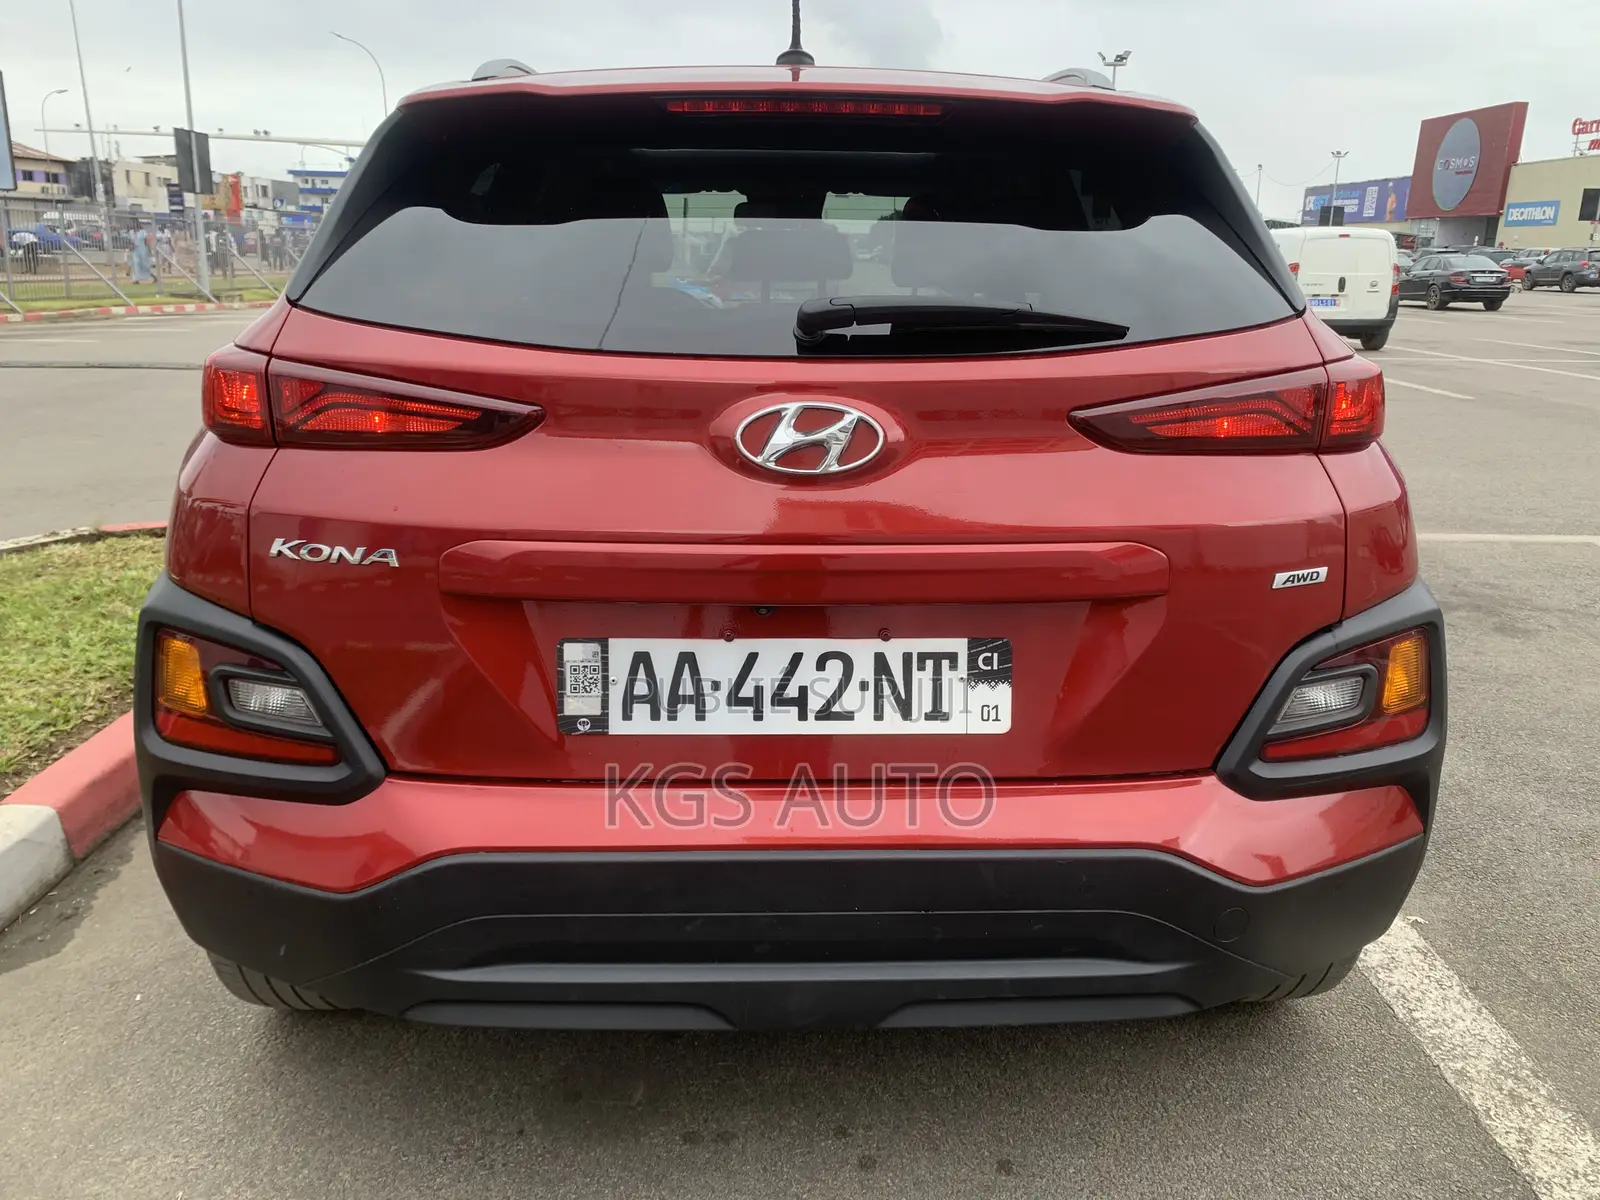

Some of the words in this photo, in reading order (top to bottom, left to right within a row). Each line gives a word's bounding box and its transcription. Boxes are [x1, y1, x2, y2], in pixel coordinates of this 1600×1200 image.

[1438, 156, 1476, 171] COSMOS
[1508, 206, 1555, 221] DECATHLON
[269, 538, 399, 567] KONA
[1282, 571, 1320, 585] AWD
[978, 652, 998, 670] CI
[981, 704, 1001, 722] 01
